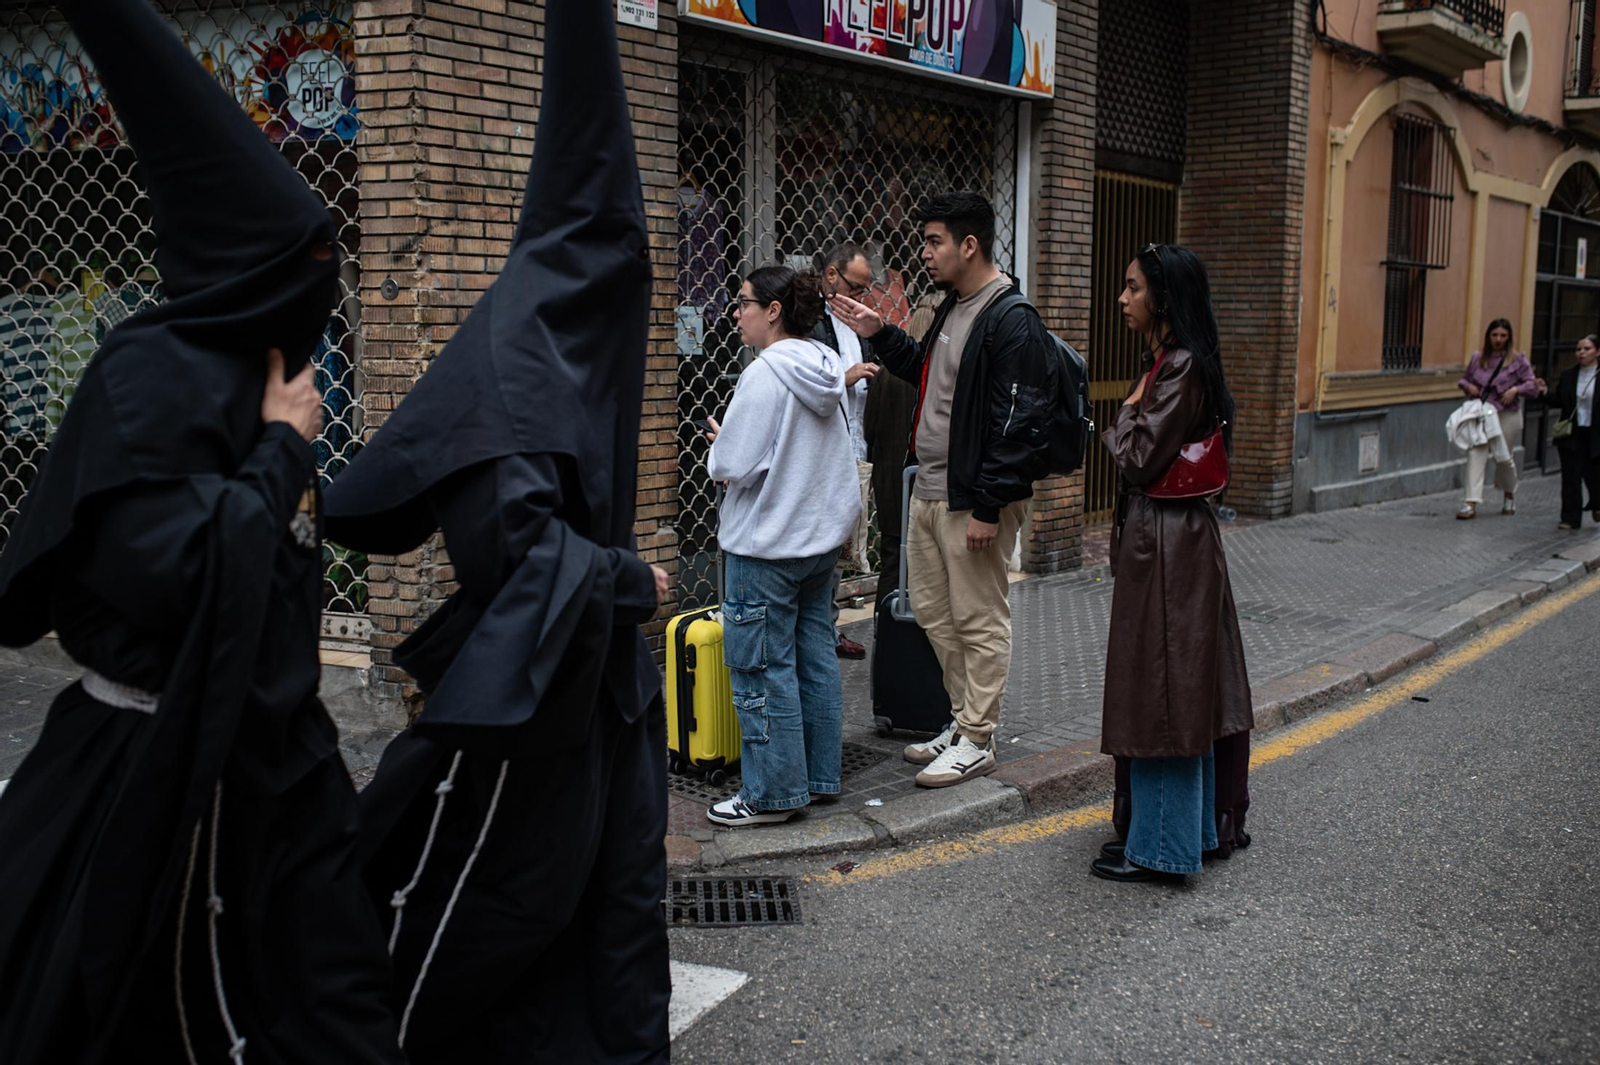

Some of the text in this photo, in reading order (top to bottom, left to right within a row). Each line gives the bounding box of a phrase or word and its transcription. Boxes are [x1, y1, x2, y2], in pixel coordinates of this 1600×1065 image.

[625, 6, 655, 19] 902 121 122
[925, 51, 934, 64] DE
[947, 57, 955, 70] 12
[301, 61, 336, 84] FEEL
[302, 87, 334, 113] POP
